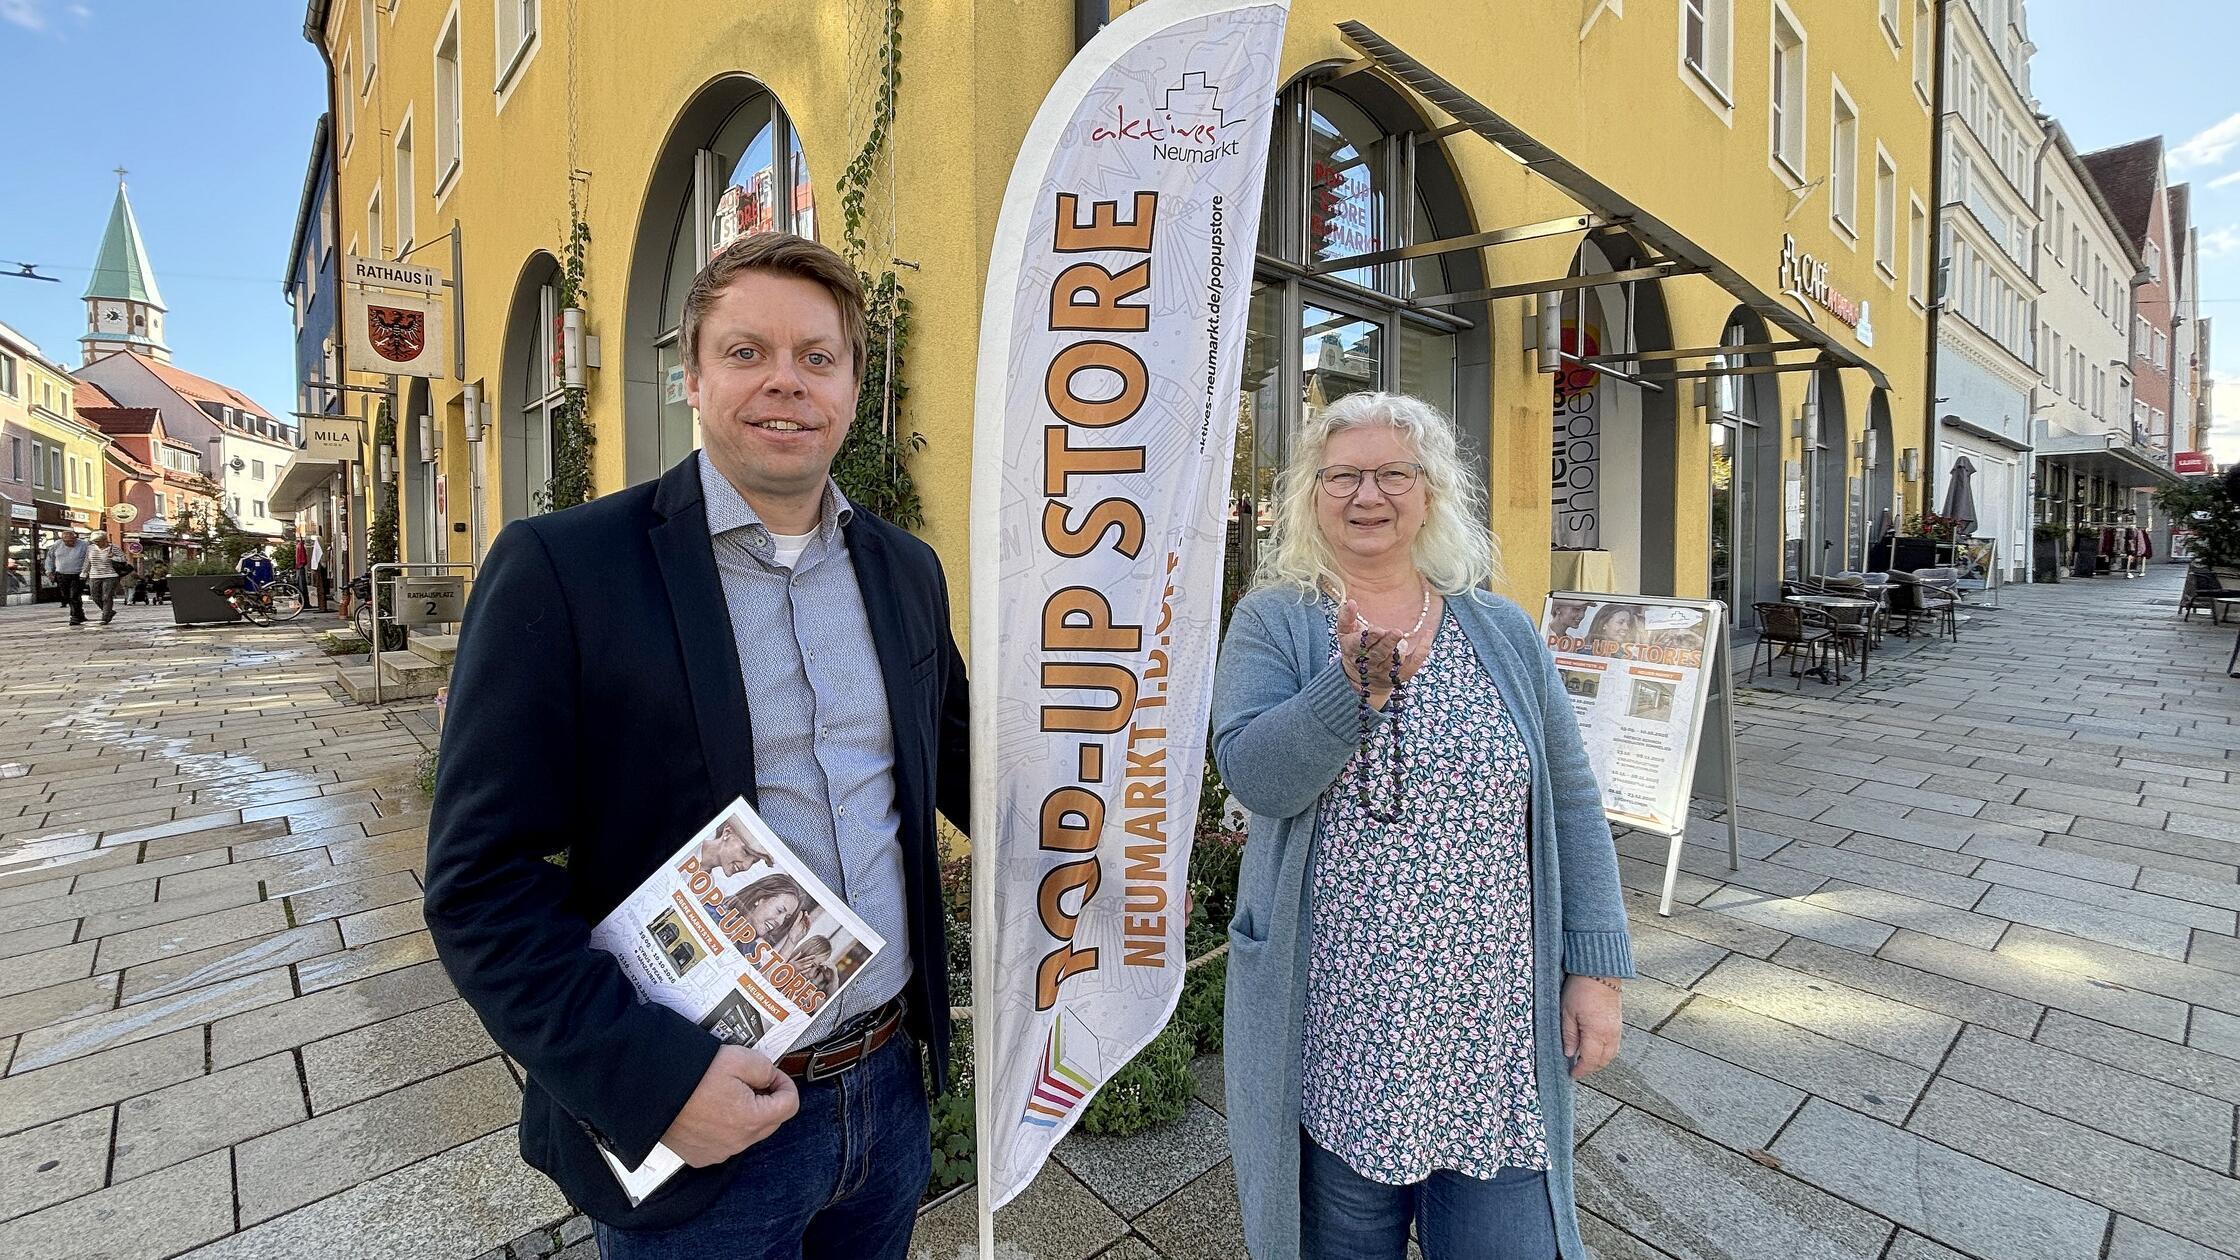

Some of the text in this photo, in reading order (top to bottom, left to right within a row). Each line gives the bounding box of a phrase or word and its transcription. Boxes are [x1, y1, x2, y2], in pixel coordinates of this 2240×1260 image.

[1092, 105, 1216, 143] aktives
[1153, 139, 1239, 164] Neumarkt
[356, 263, 422, 285] RATHAUS
[314, 431, 350, 442] MILA
[1559, 367, 1600, 532] shoppen
[407, 591, 454, 599] RATHAUSPLATZ
[425, 601, 438, 616] 2
[1035, 191, 1159, 1011] POP-UP STORE
[1547, 634, 1620, 658] POP-UP
[1620, 642, 1703, 668] STORES
[1123, 722, 1168, 968] NEUMARKT
[675, 895, 691, 915] OBERE
[677, 855, 827, 1014] POP-UP STORES
[747, 983, 781, 1016] NEUER MARKT
